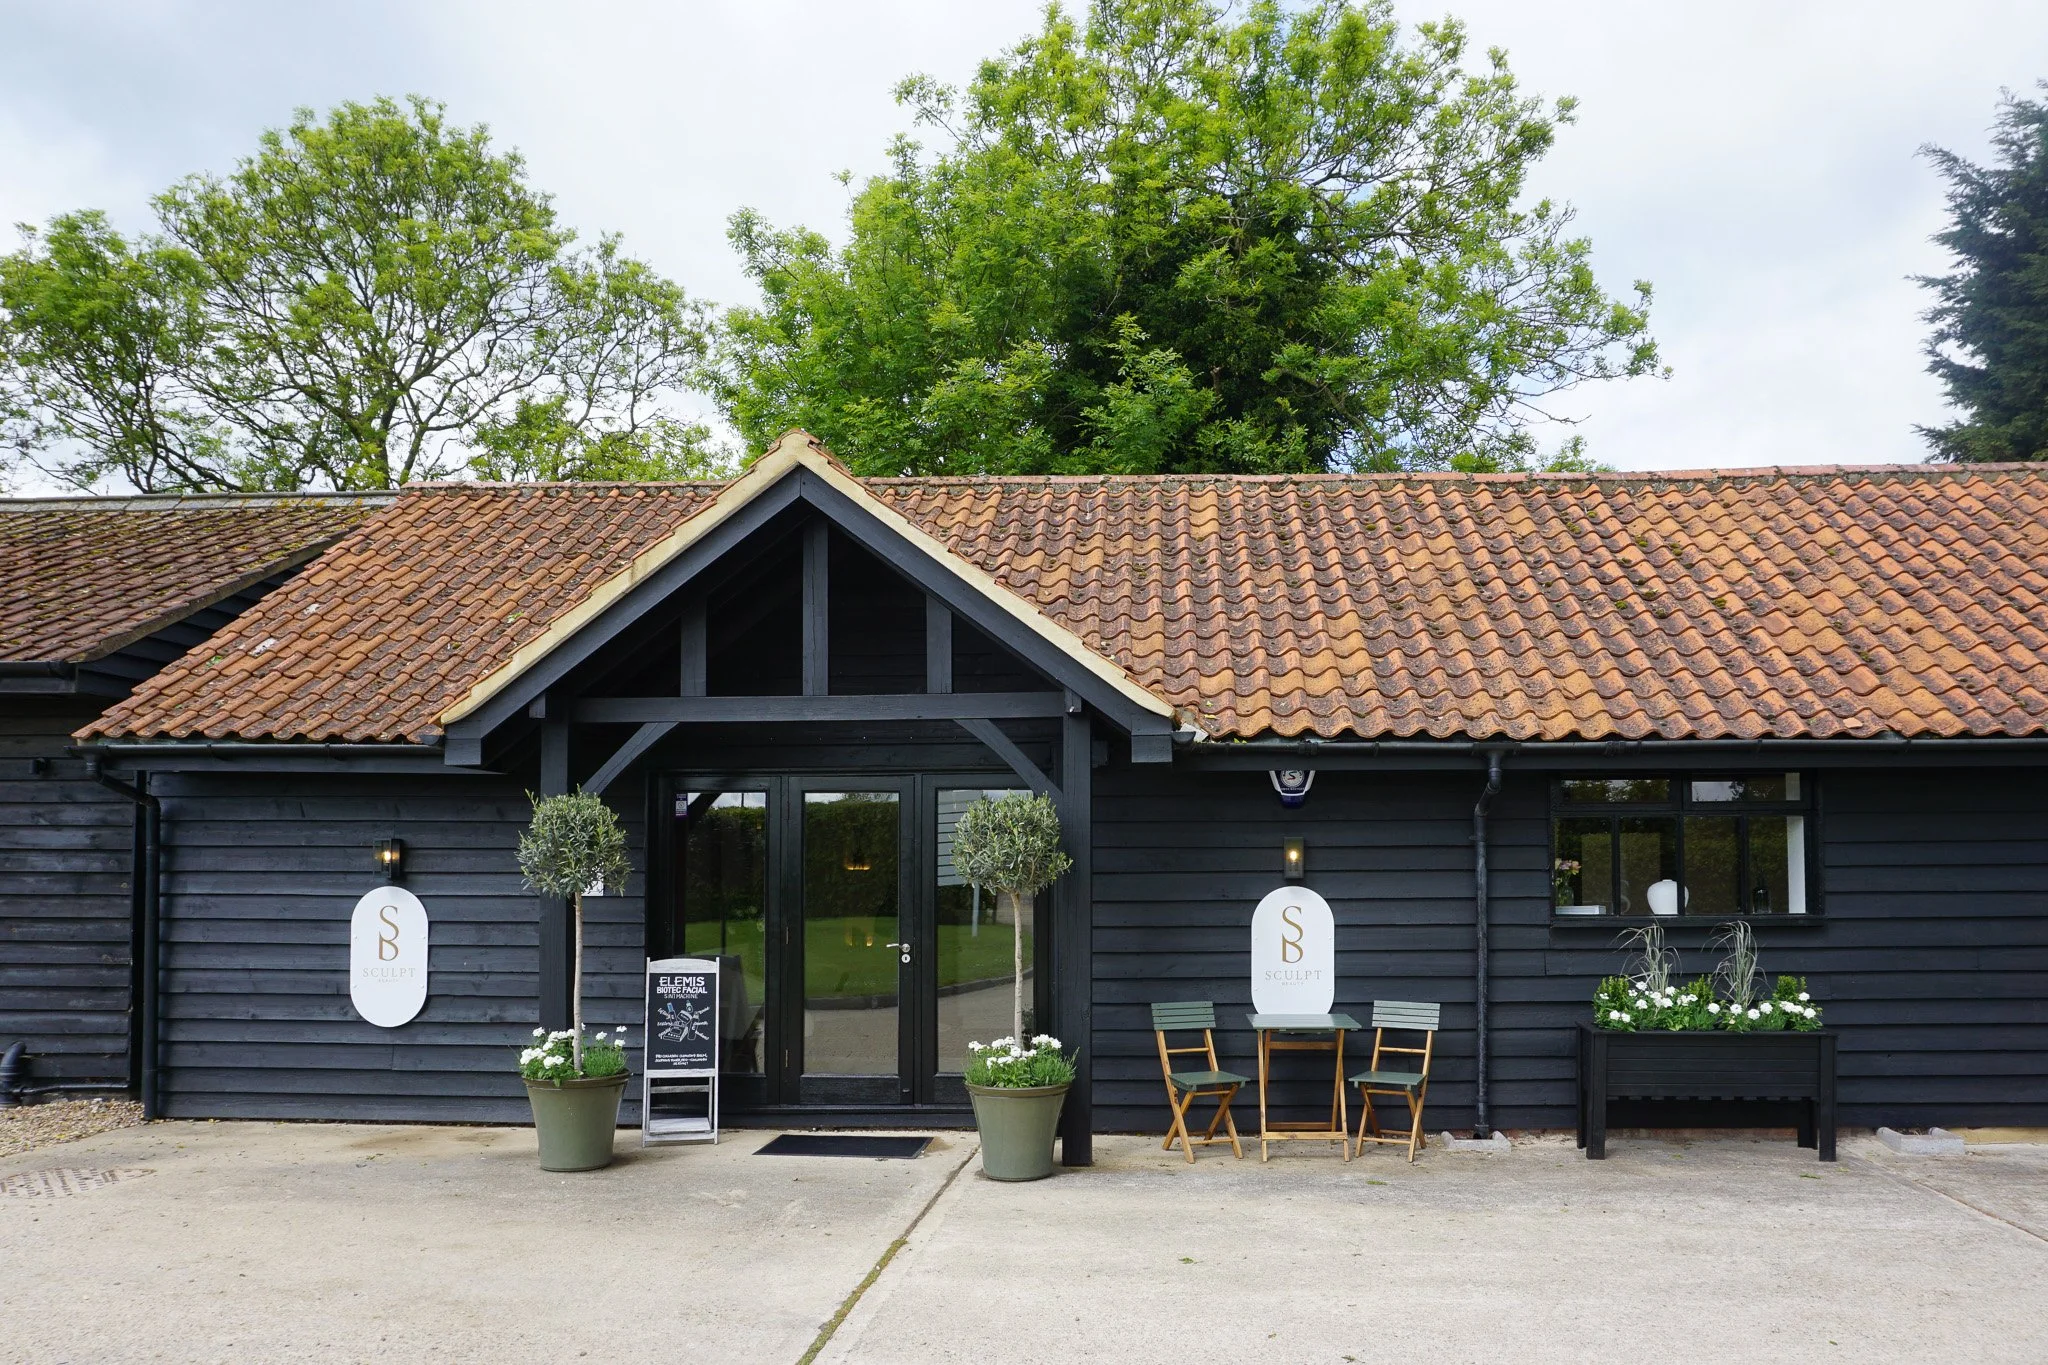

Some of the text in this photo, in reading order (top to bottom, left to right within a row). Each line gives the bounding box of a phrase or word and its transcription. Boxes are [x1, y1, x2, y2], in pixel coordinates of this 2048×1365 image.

[362, 967, 416, 978] SCULPT
[1265, 970, 1322, 981] SCULPT
[659, 976, 705, 986] ELEMIS
